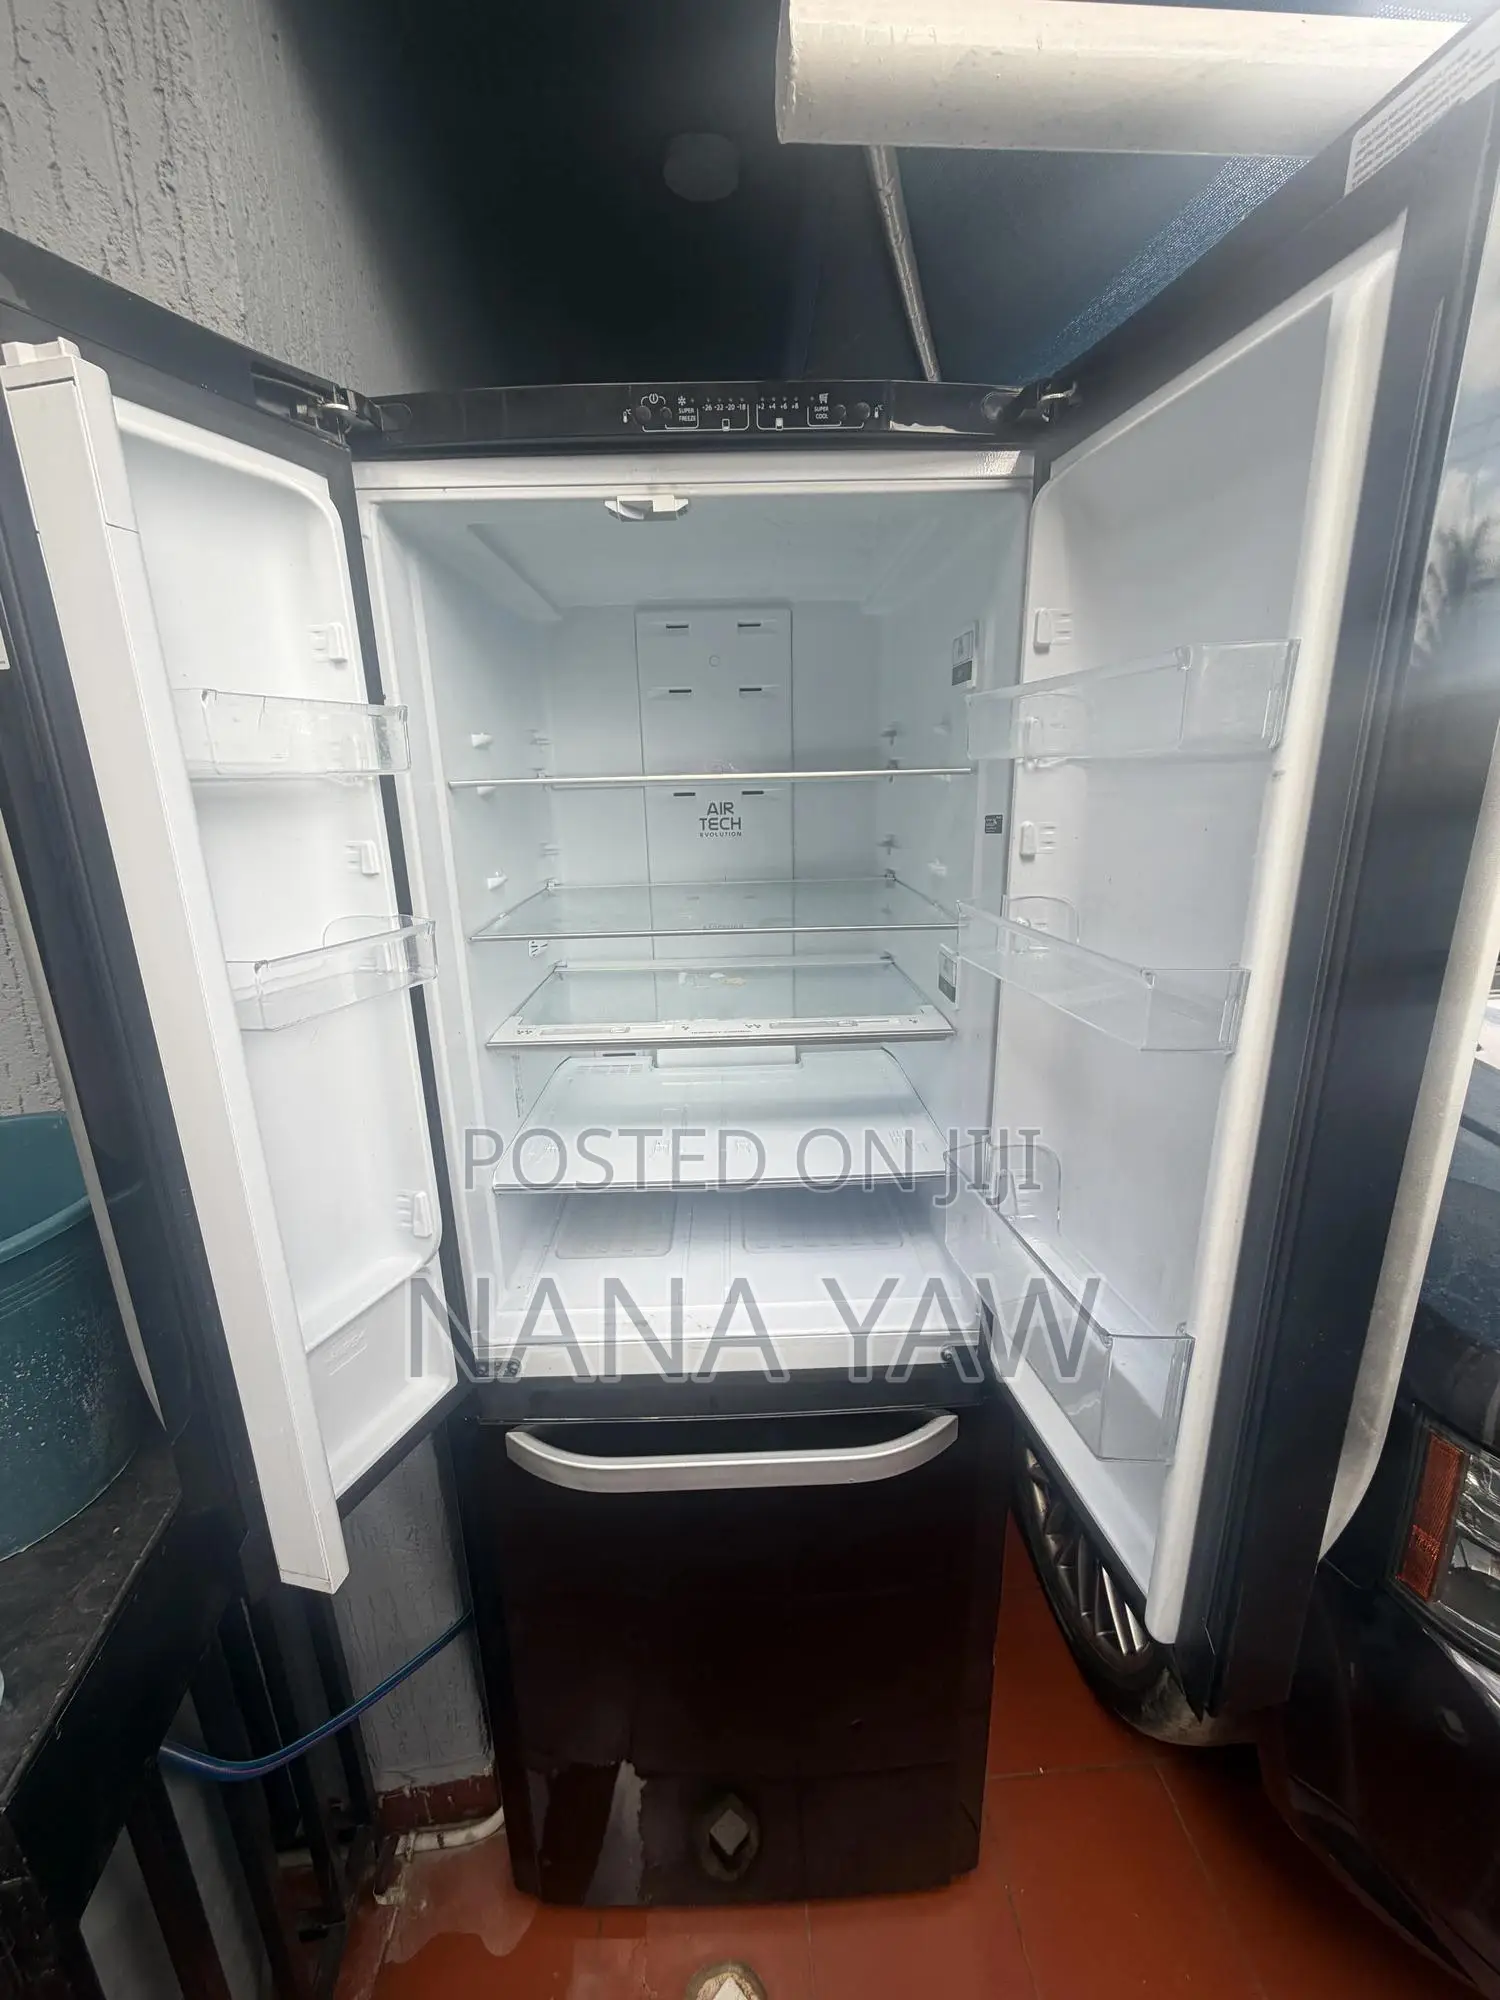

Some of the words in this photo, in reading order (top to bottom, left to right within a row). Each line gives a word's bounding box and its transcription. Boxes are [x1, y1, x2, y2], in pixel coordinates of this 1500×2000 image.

[702, 403, 712, 411] -26
[725, 403, 735, 411] -20
[737, 403, 746, 411] -18
[707, 801, 735, 816] AIR
[699, 817, 742, 831] TECH
